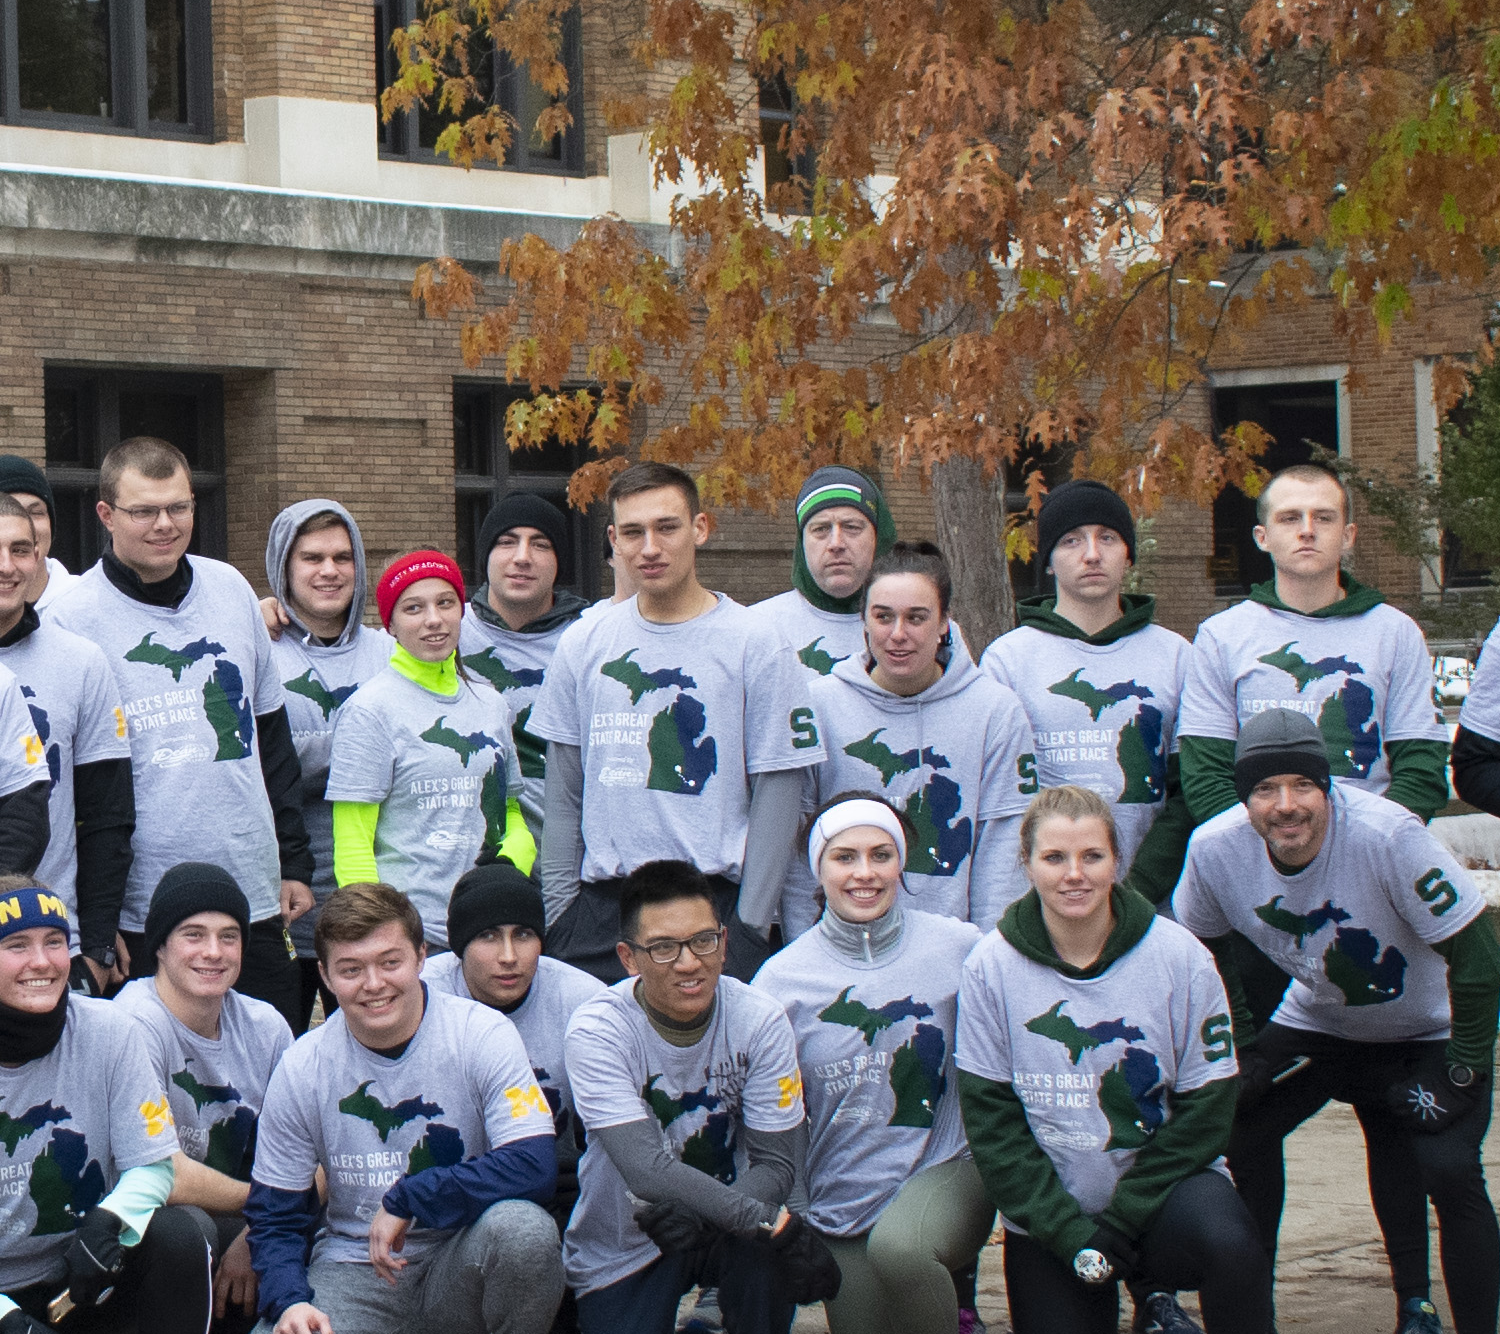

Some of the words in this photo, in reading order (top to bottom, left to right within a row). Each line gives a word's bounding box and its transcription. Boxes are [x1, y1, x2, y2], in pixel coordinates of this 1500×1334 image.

[124, 694, 163, 718] ALEX'S
[164, 688, 198, 707] GREAT
[134, 712, 168, 732] STATE
[169, 707, 198, 725] RACE
[615, 712, 649, 728] GREAT
[790, 707, 819, 749] S
[613, 730, 642, 746] RACE
[1038, 730, 1076, 745] ALEX'S
[1078, 729, 1113, 744] GREAT
[1044, 748, 1077, 762] STATE
[1079, 747, 1109, 761] RACE
[1017, 753, 1039, 794] S
[411, 778, 448, 794] ALEX'S
[450, 775, 479, 791] GREAT
[418, 796, 448, 810] STATE
[450, 794, 475, 808] RACE
[1415, 867, 1458, 917] S
[1201, 1013, 1231, 1063] S
[1056, 1074, 1095, 1089] GREAT
[1056, 1093, 1091, 1108] RACE
[330, 1154, 364, 1169] ALEX'S
[366, 1151, 403, 1168] GREAT
[338, 1171, 366, 1186] STATE
